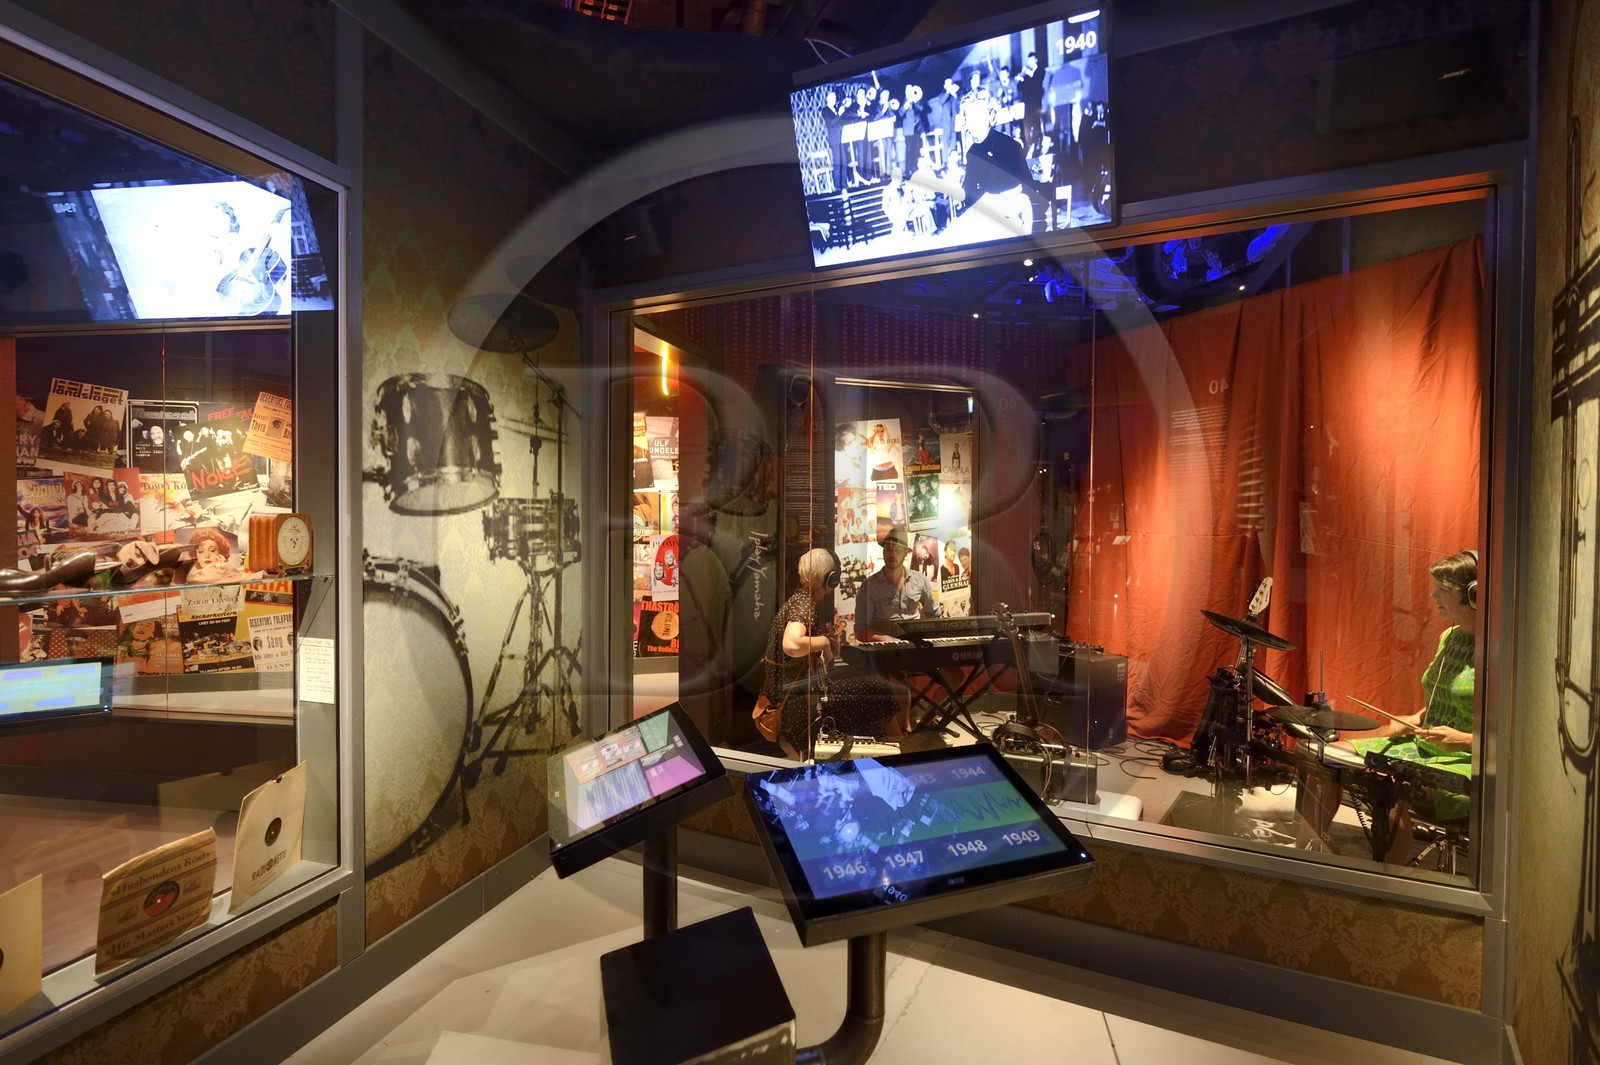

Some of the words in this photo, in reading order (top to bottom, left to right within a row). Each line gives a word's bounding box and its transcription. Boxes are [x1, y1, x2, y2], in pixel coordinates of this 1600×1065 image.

[1055, 30, 1097, 56] 1940
[208, 407, 235, 422] FREE
[748, 536, 768, 565] play
[747, 564, 768, 621] Yamaha
[952, 766, 986, 782] 1944
[823, 861, 867, 881] 1946
[885, 850, 925, 869] 1947
[948, 839, 988, 858] 1948
[1003, 829, 1041, 848] 1949
